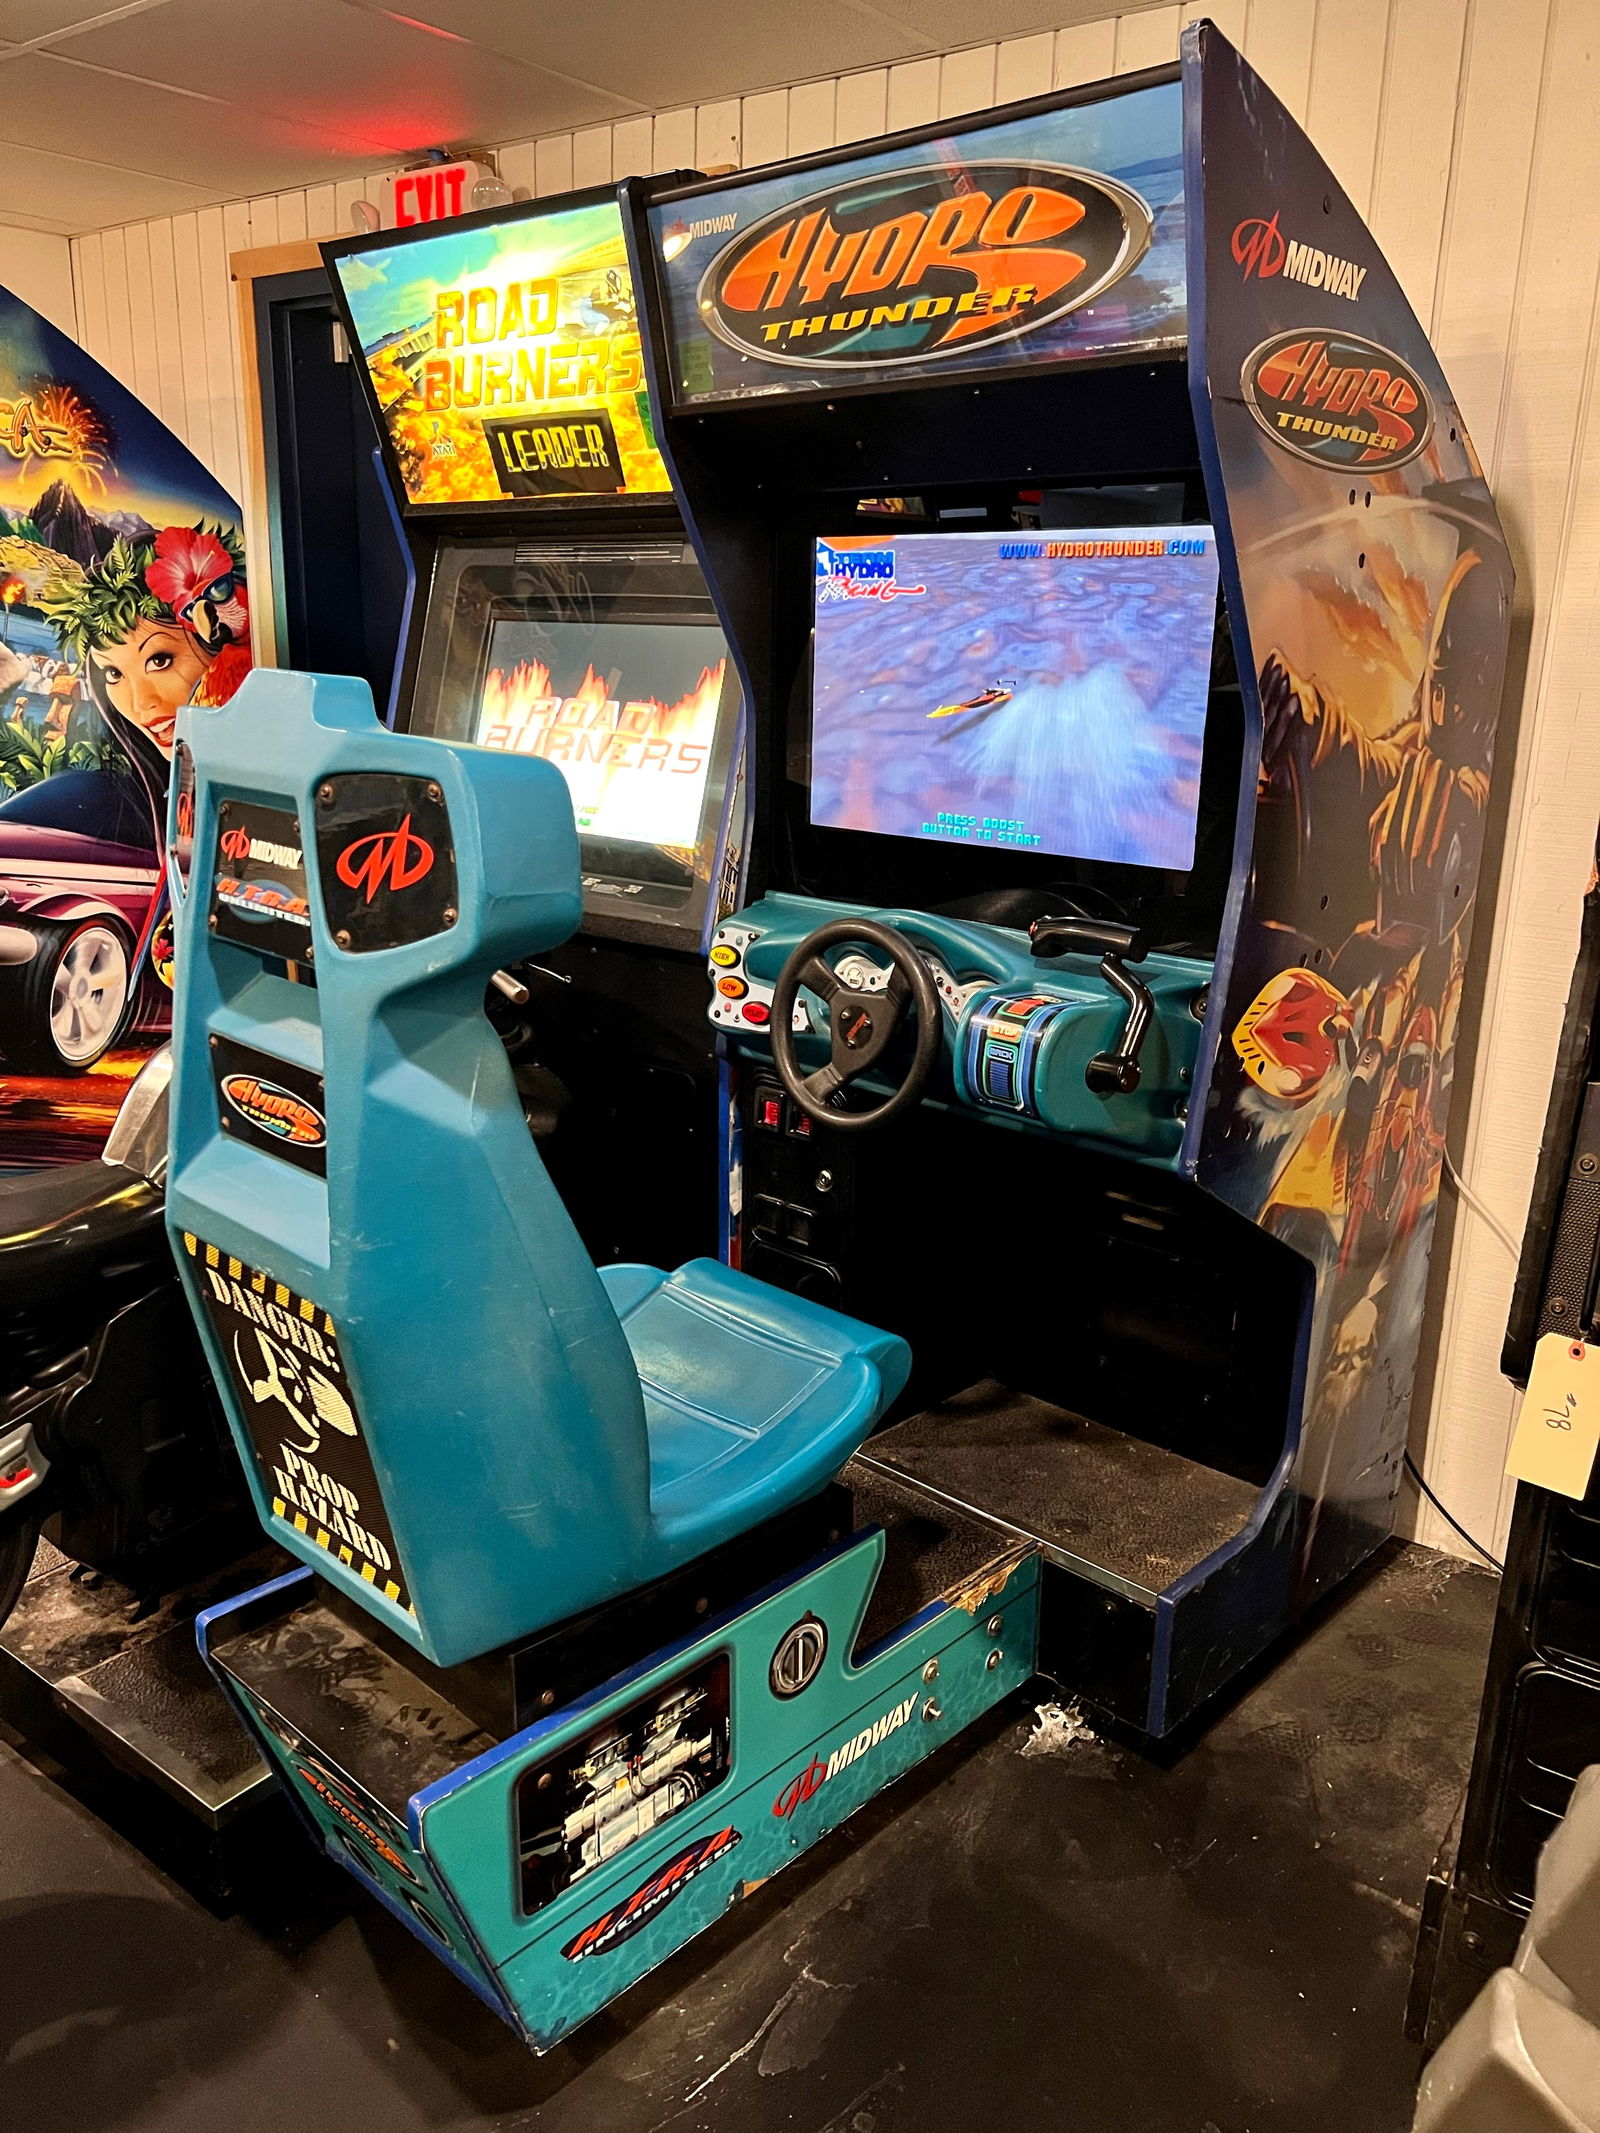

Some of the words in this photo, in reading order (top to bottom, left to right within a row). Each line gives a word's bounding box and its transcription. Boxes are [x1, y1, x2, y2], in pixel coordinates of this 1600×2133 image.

[689, 212, 738, 240] MIDWAY
[722, 186, 1086, 348] HYDRO
[1283, 239, 1367, 301] MIDWAY
[436, 277, 560, 349] ROAD
[760, 283, 1037, 342] THUNDER
[424, 333, 642, 411] BURNERS
[1257, 340, 1419, 462] HYDRO
[432, 444, 456, 455] ATARI
[498, 424, 610, 473] LEADER
[1277, 412, 1398, 451] THUNDER
[835, 551, 895, 566] TEAM
[835, 563, 895, 579] HYDRO
[1000, 539, 1205, 559] WWW.HYDROTHUNDER.COM
[525, 696, 657, 736] ROAD
[484, 725, 708, 774] BURNERS
[922, 822, 970, 838] BUTTON
[976, 828, 993, 841] TO
[998, 831, 1041, 846] START
[937, 812, 977, 827] PRESS
[983, 817, 1025, 832] BOOST
[249, 838, 303, 870] MIDWAY
[713, 951, 731, 961] HIGH
[721, 983, 738, 992] LOW
[228, 1080, 320, 1141] HYDRO
[206, 1267, 340, 1373] DANGER:
[279, 1443, 360, 1519] PROP
[272, 1465, 392, 1571] HAZARD
[825, 1691, 920, 1782] MIDWAY
[573, 1841, 735, 1964] UNLIMITED
